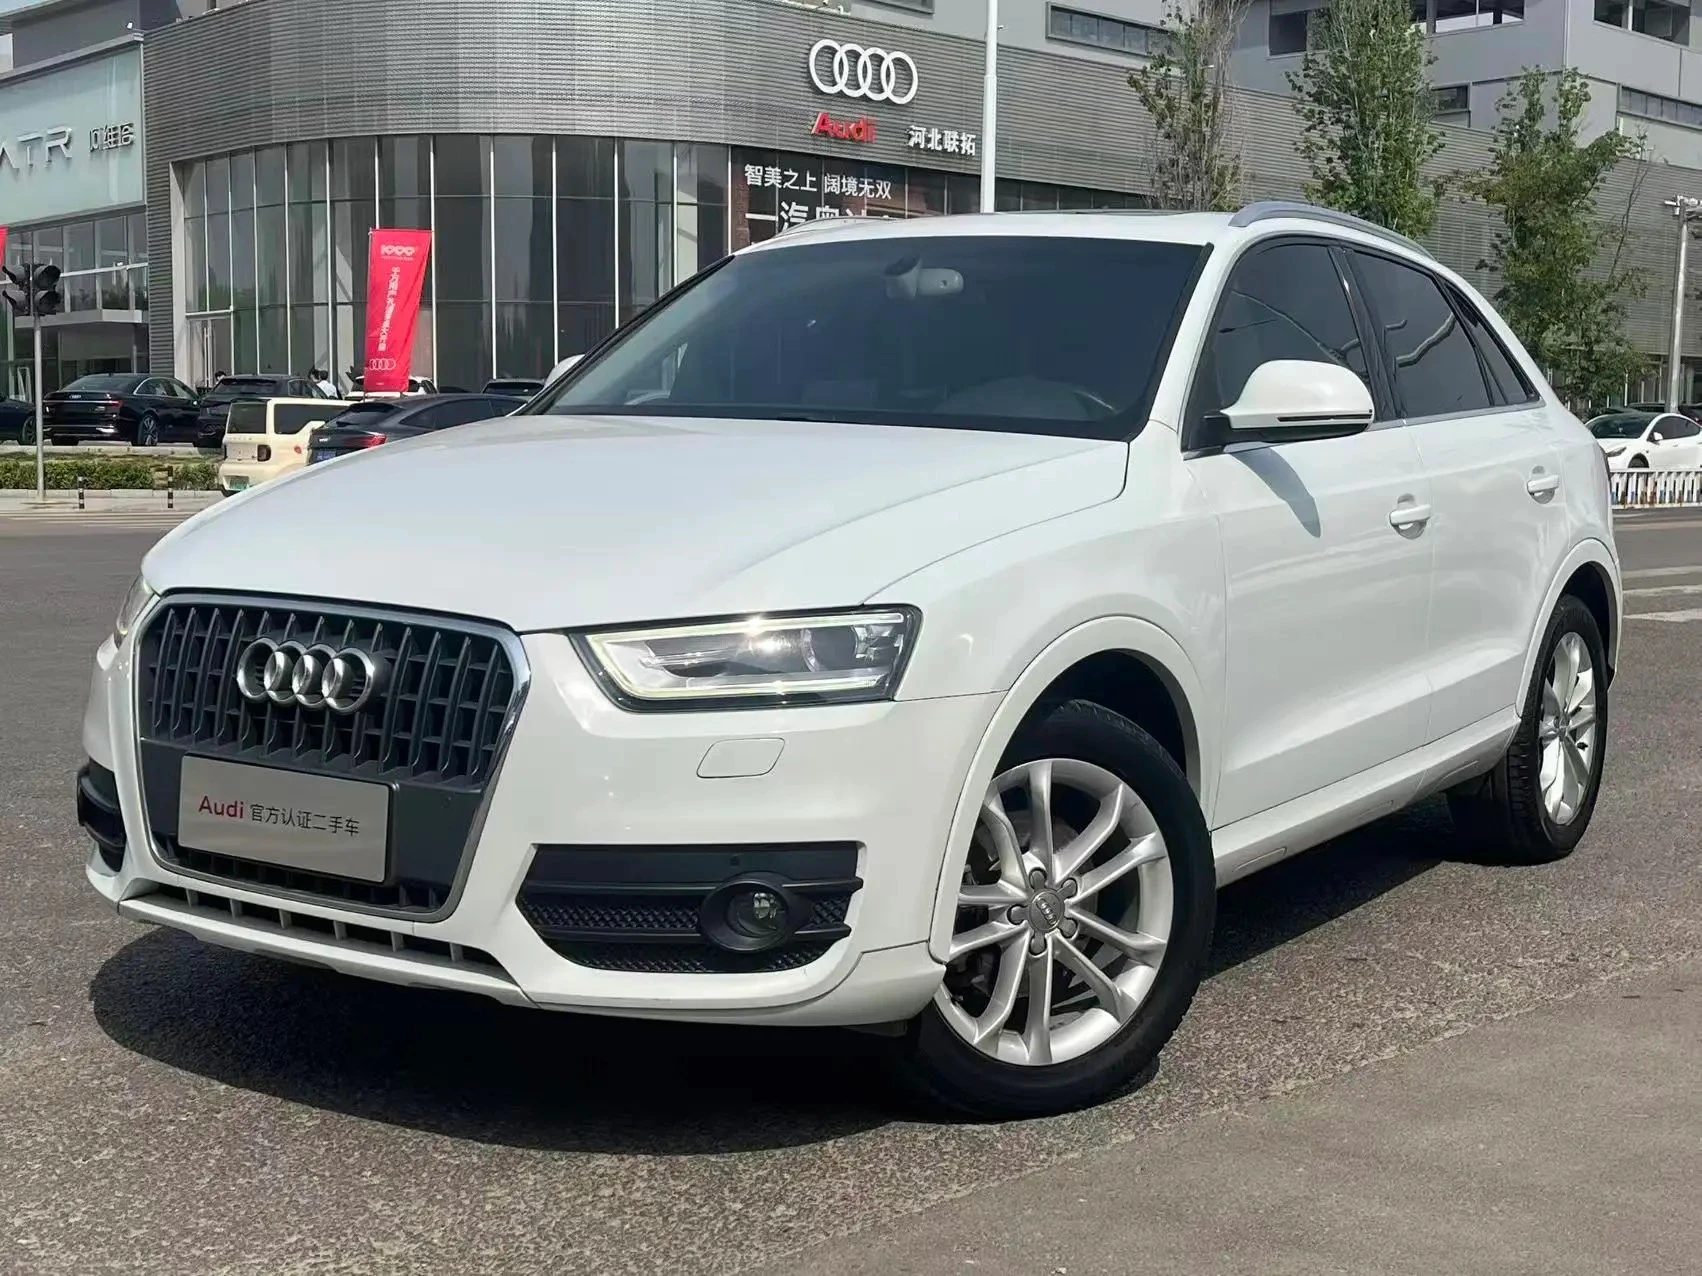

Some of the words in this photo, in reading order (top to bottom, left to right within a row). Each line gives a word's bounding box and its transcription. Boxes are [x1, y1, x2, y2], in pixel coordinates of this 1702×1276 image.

[811, 112, 877, 143] Audi
[907, 126, 977, 156] 河北联拓
[744, 163, 817, 192] 智美之上
[823, 173, 892, 200] 阔境无双
[199, 795, 245, 819] Audi
[249, 804, 361, 837] 官方认证二手车
